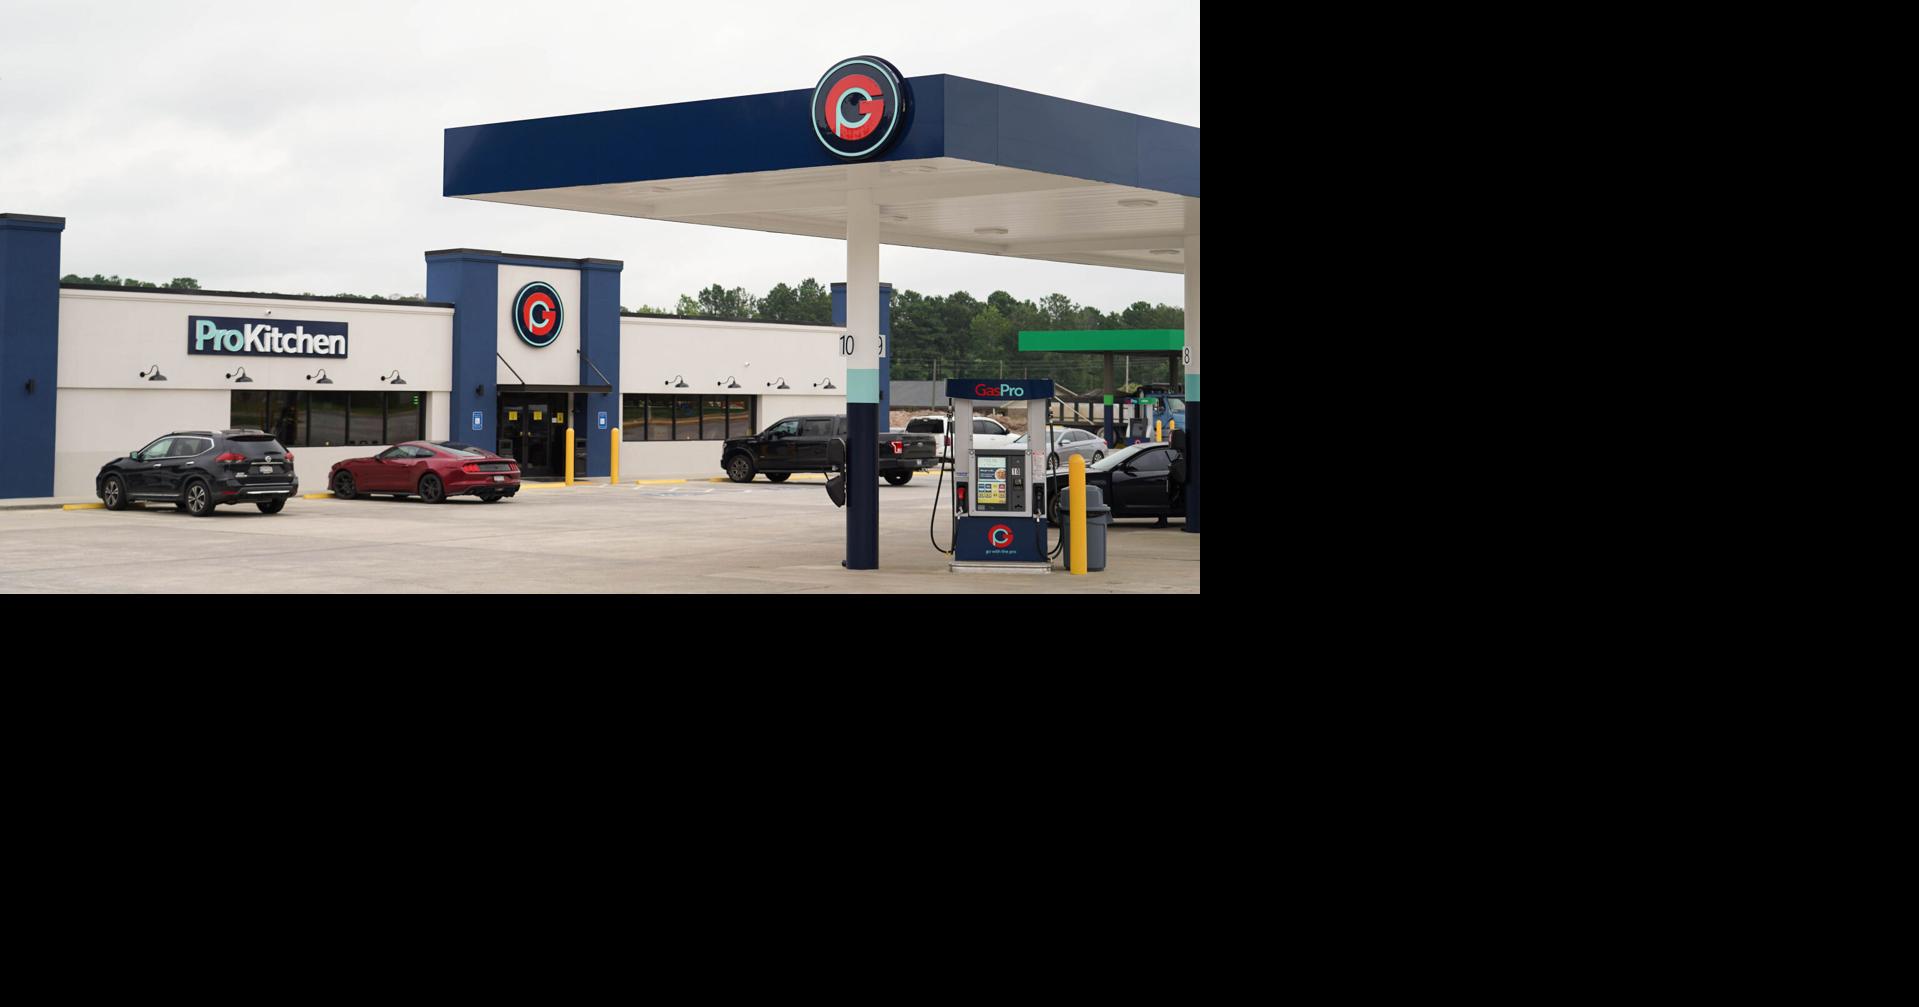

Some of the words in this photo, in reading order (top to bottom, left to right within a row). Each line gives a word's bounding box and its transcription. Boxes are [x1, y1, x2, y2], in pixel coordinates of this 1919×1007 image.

[195, 319, 346, 355] ProKitchen
[840, 335, 855, 356] 10
[1184, 347, 1190, 364] 8
[975, 383, 1025, 397] GasPro
